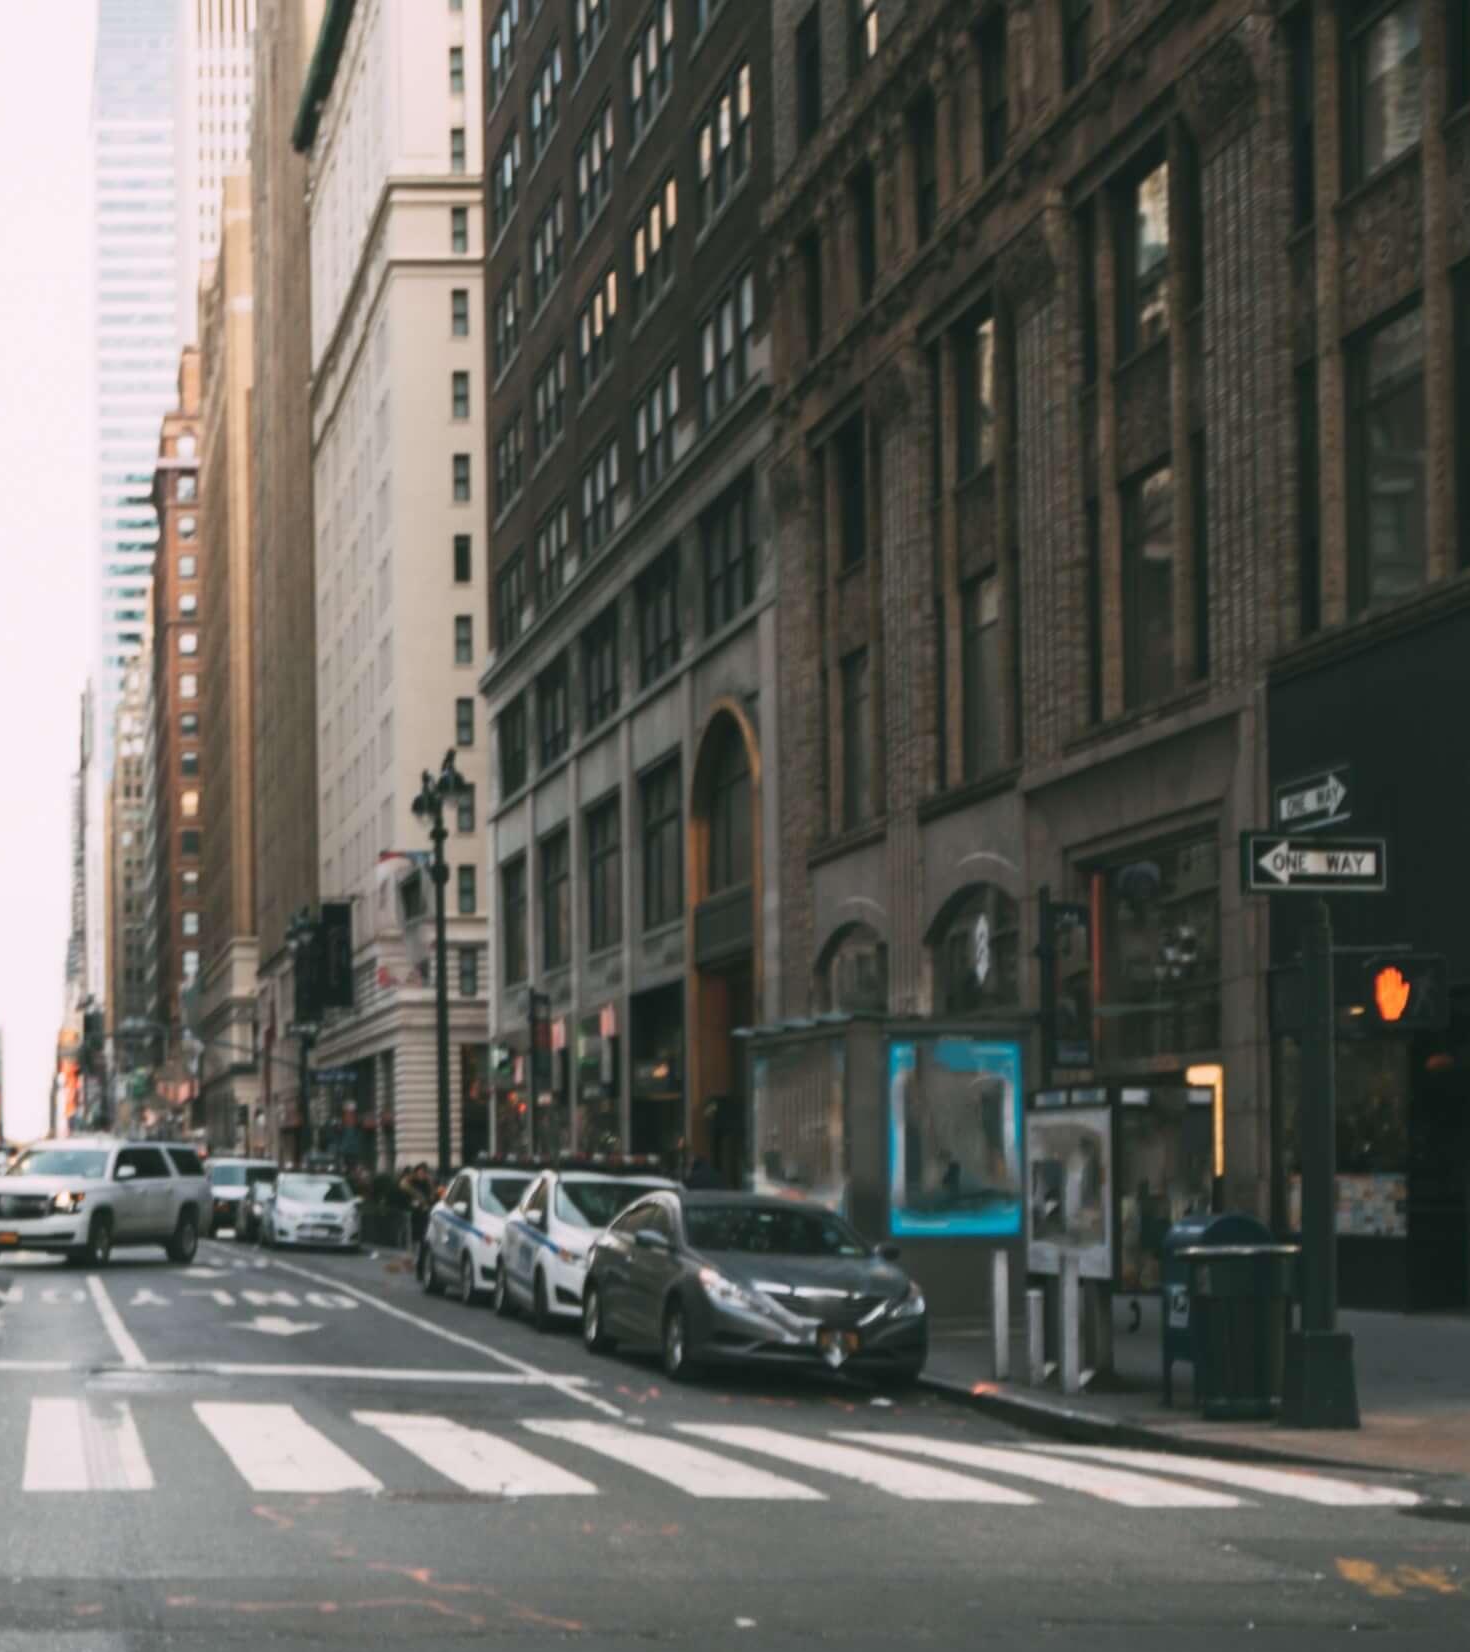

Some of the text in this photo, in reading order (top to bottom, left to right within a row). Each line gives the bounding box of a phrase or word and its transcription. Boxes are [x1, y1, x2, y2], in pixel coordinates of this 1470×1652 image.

[1286, 783, 1341, 815] ONE WAY
[1272, 853, 1366, 873] ONE WAY
